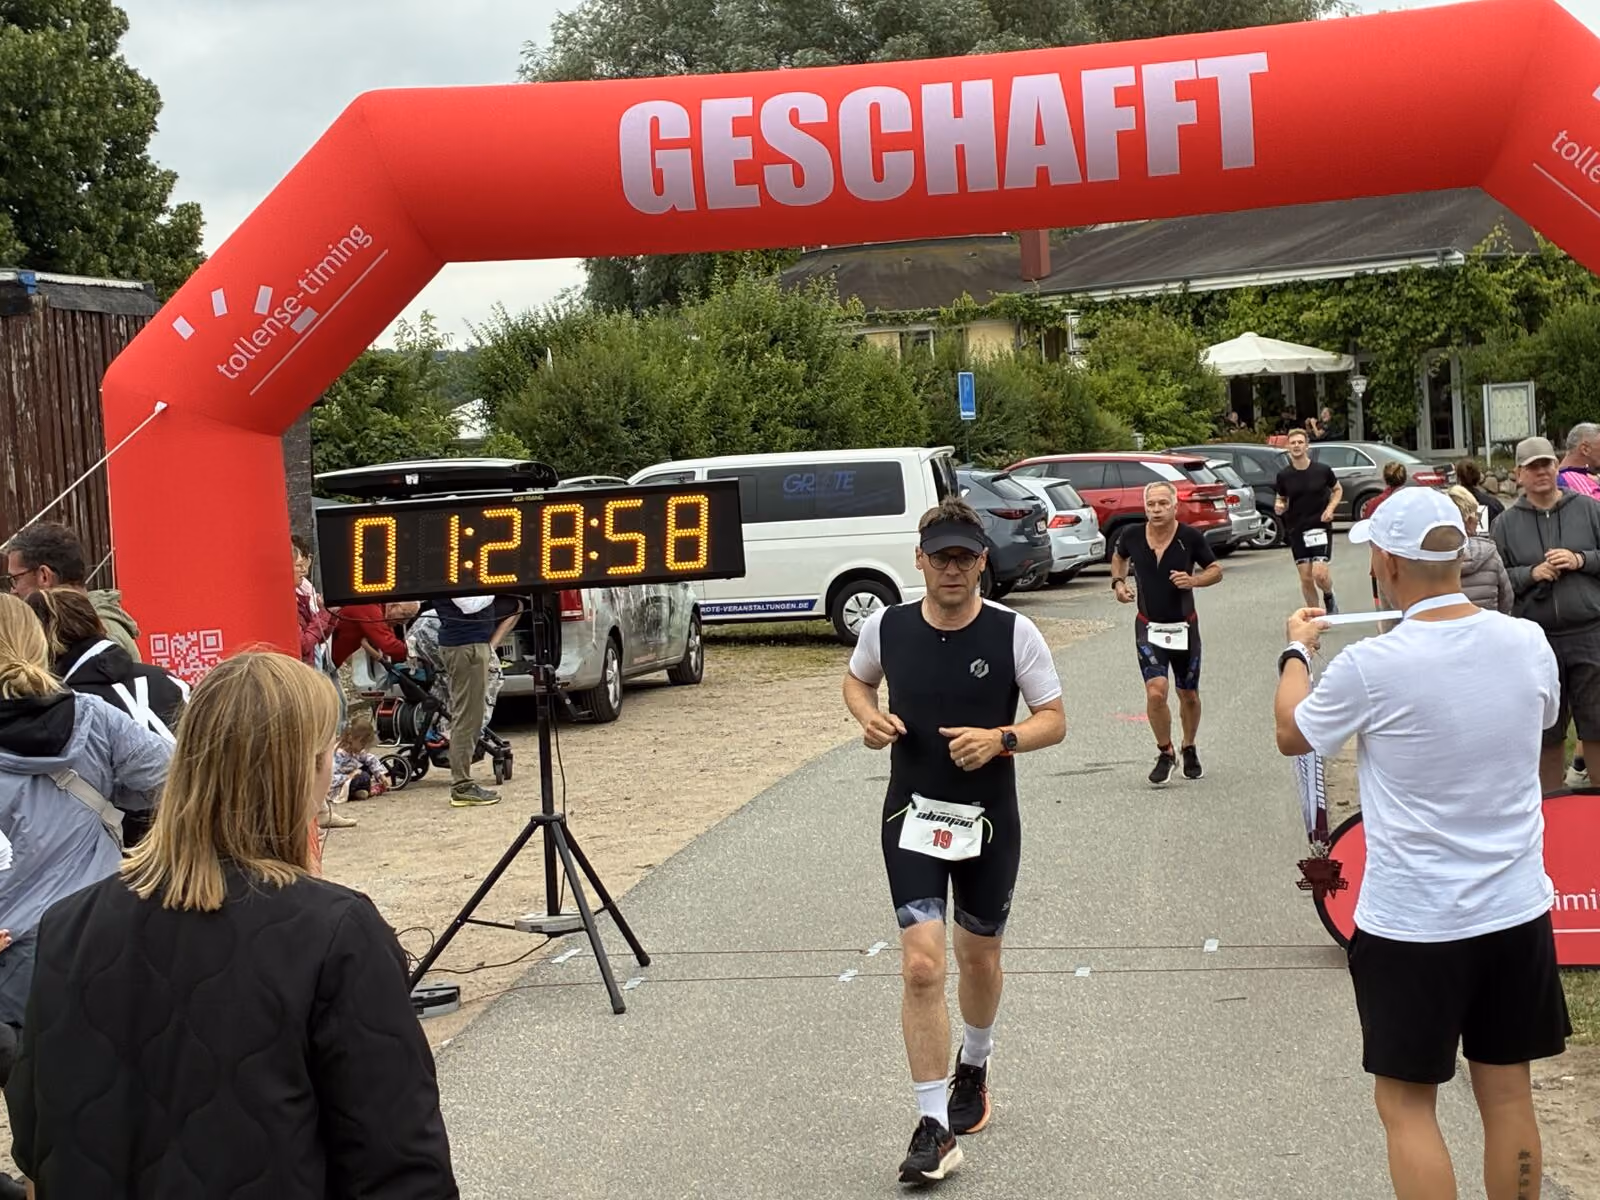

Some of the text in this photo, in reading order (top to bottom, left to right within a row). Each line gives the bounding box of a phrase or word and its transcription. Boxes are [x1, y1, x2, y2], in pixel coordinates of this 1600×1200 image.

[619, 52, 1268, 215] GESCHAFFT
[216, 224, 373, 380] tollense-timing
[932, 828, 953, 850] 19
